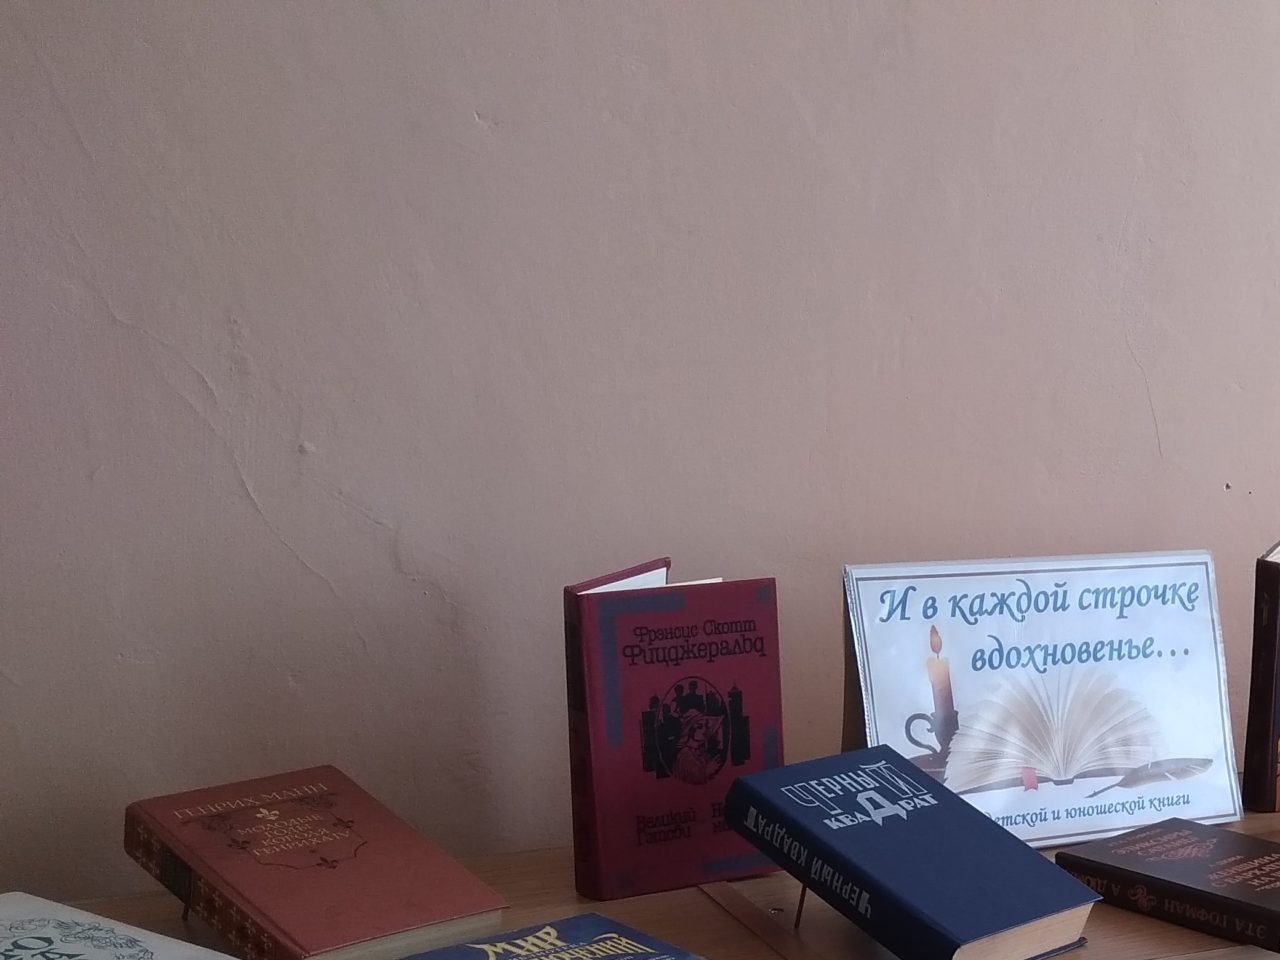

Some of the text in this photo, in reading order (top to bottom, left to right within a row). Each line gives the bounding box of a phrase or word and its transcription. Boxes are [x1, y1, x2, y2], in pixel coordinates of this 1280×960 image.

[879, 578, 1200, 625] И в каждой строчке
[633, 618, 757, 643] Фрэнсис Скотт
[622, 634, 767, 666] Фицджеральд
[173, 782, 329, 820] ГЕНРИХ МАНН
[1052, 808, 1062, 820] и
[1065, 795, 1145, 820] юношеской
[1148, 792, 1191, 813] книги
[236, 813, 324, 836] МОЛОДЫЕ
[263, 823, 313, 840] ГОДЫ
[261, 828, 329, 848] КОРОЛЯ
